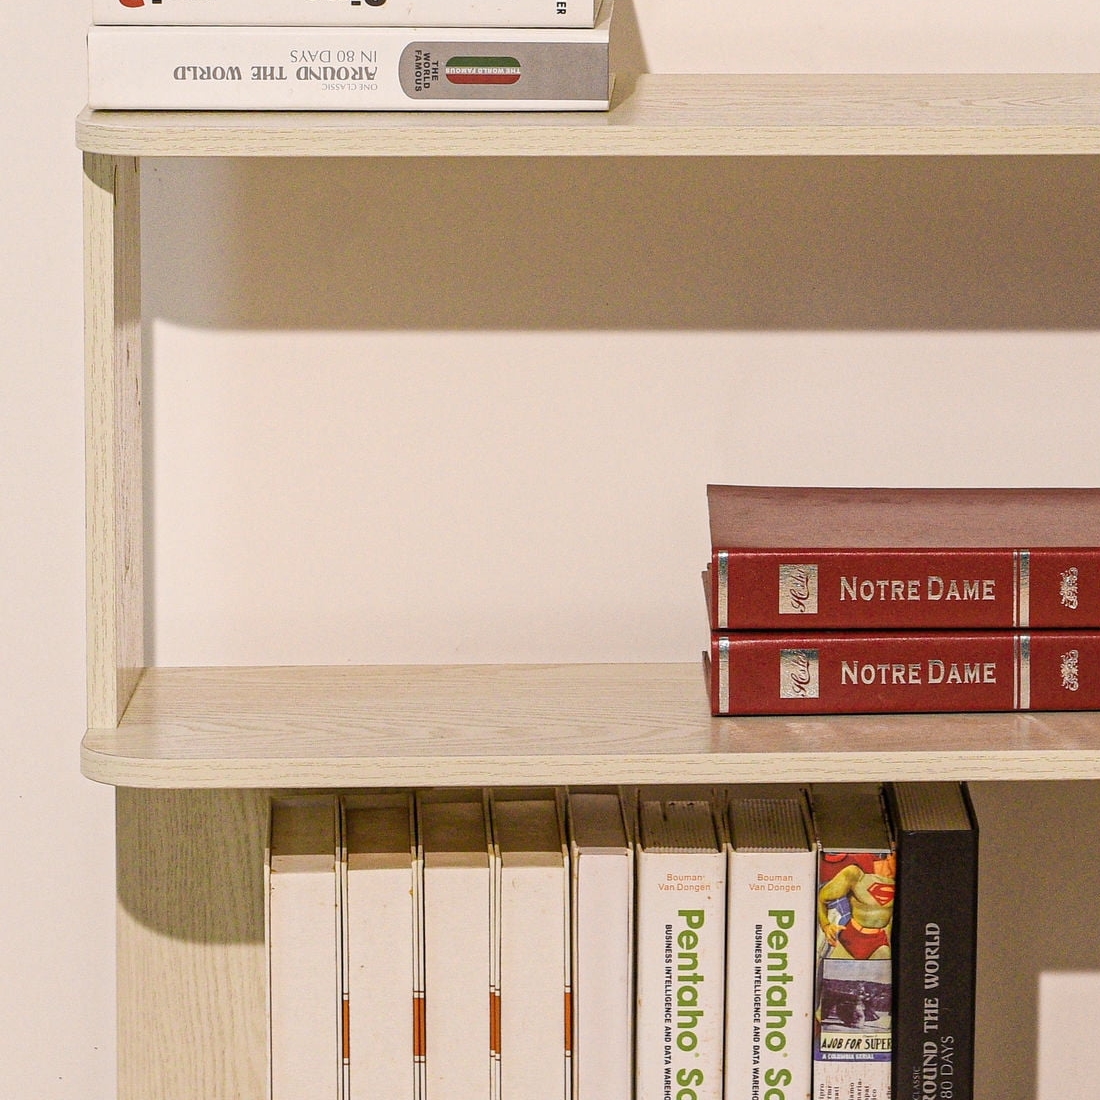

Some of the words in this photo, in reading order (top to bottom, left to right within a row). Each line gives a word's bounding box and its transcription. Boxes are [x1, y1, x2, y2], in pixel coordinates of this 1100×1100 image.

[290, 49, 331, 63] DAYS
[336, 49, 354, 63] 80
[360, 49, 378, 63] IN
[173, 65, 243, 81] WORLD
[250, 65, 288, 81] THE
[296, 65, 378, 81] AROUND
[414, 49, 422, 92] FAMOUS
[423, 52, 431, 89] WORLD
[445, 67, 476, 75] FAMOUS
[477, 67, 505, 75] WORLD
[505, 67, 521, 75] THE
[321, 83, 357, 91] CLASSIC
[359, 83, 378, 91] ONE
[839, 576, 921, 601] NOTRE
[927, 575, 996, 601] DAME
[840, 660, 922, 685] NOTRE
[927, 659, 997, 685] DAME
[666, 873, 703, 882] Bouman
[757, 873, 793, 882] Bouman
[658, 883, 675, 891] Van
[676, 883, 711, 893] Dongen
[749, 883, 766, 891] Van
[767, 883, 801, 893] Dongen
[664, 924, 673, 964] BUSINESS
[754, 924, 763, 964] BUSINESS
[924, 922, 941, 990] WORLD
[676, 909, 705, 1052] Pentaho
[765, 909, 795, 1052] Pentaho
[664, 966, 673, 1023] INTELLIGENCE
[753, 966, 762, 1023] INTELLIGENCE
[923, 997, 939, 1033] THE
[664, 1026, 672, 1043] AND
[752, 1026, 760, 1043] AND
[821, 1038, 827, 1049] A
[827, 1038, 843, 1049] JOB
[844, 1038, 863, 1050] FOR
[664, 1045, 672, 1065] DATA
[752, 1045, 760, 1065] DATA
[940, 1035, 955, 1076] DAYS
[940, 1081, 953, 1099] 80
